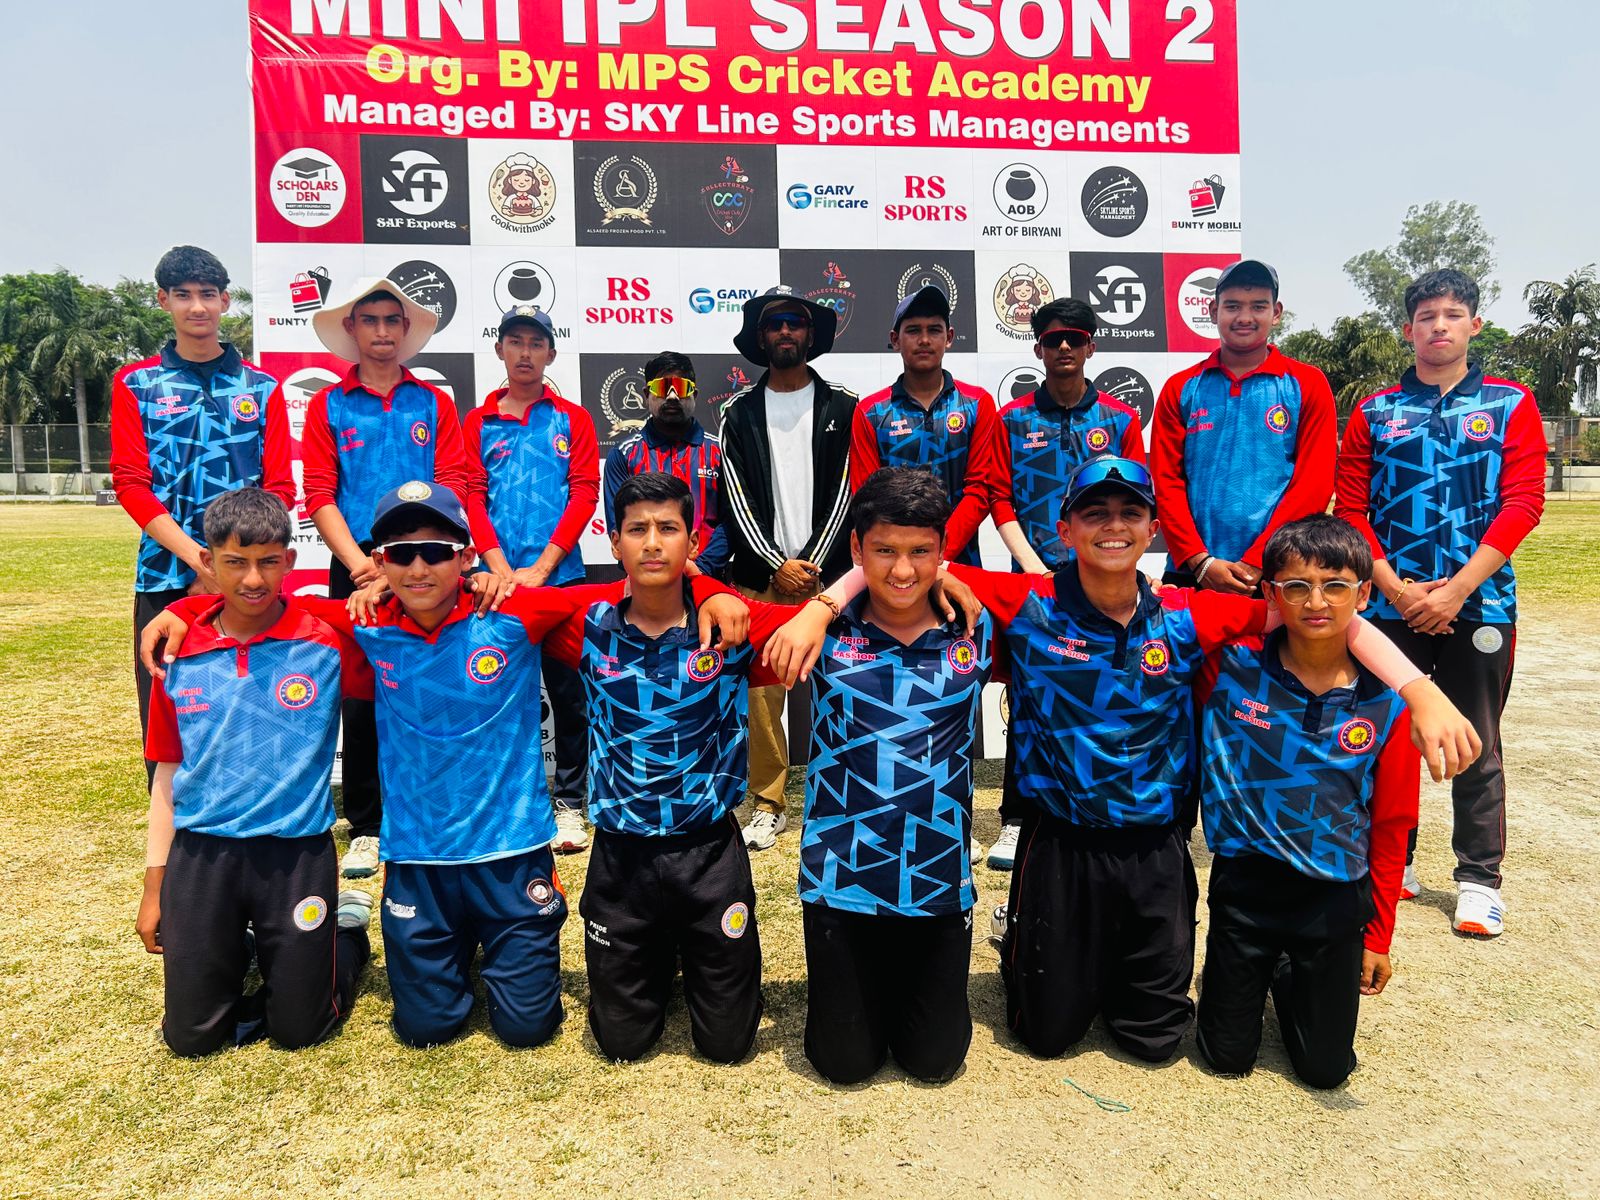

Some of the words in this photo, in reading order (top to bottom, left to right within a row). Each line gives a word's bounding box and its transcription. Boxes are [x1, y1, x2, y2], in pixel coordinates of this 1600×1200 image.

[290, 0, 521, 41] MINI
[563, 0, 717, 47] IPL
[750, 0, 1131, 60] SEASON
[1164, 0, 1215, 62] 2
[366, 44, 479, 96] Org.
[499, 49, 578, 99] By:
[598, 52, 710, 93] MPS
[728, 56, 912, 97] Cricket
[927, 61, 1151, 113] Academy
[324, 94, 515, 136] Managed
[529, 101, 590, 138] By:
[605, 102, 684, 132] SKY
[697, 105, 779, 134] Line
[792, 106, 916, 143] Sports
[929, 109, 1190, 148] Managements
[277, 180, 338, 192] SCHOLARS
[814, 185, 855, 196] GARV
[905, 175, 946, 199] RS
[296, 192, 321, 202] DEN
[814, 197, 869, 209] Fincare
[884, 204, 968, 222] SPORTS
[1007, 204, 1036, 215] AOB
[1100, 207, 1118, 215] SKYLINE
[376, 217, 404, 228] SAF
[406, 218, 457, 231] Exports
[490, 214, 556, 235] cookwithmoku
[1171, 221, 1205, 230] BUNTY
[982, 225, 1003, 236] ART
[1005, 226, 1018, 237] OF
[1021, 226, 1062, 237] BIRYANI
[606, 277, 651, 301] RS
[716, 289, 758, 301] GARV
[268, 317, 308, 327] BUNTY
[585, 307, 674, 325] SPORTS
[995, 321, 1036, 341] cookwith
[1094, 327, 1110, 337] AF
[1111, 328, 1156, 340] Exports
[1381, 429, 1412, 440] PASSION
[290, 534, 313, 543] NTY
[840, 635, 870, 646] PRIDE
[1057, 635, 1087, 647] PRIDE
[850, 644, 858, 652] &
[1048, 644, 1091, 661] PASSION
[832, 650, 876, 661] PASSION
[1241, 697, 1270, 714] PRIDE
[1249, 709, 1257, 718] &
[1234, 710, 1271, 730] PASSION
